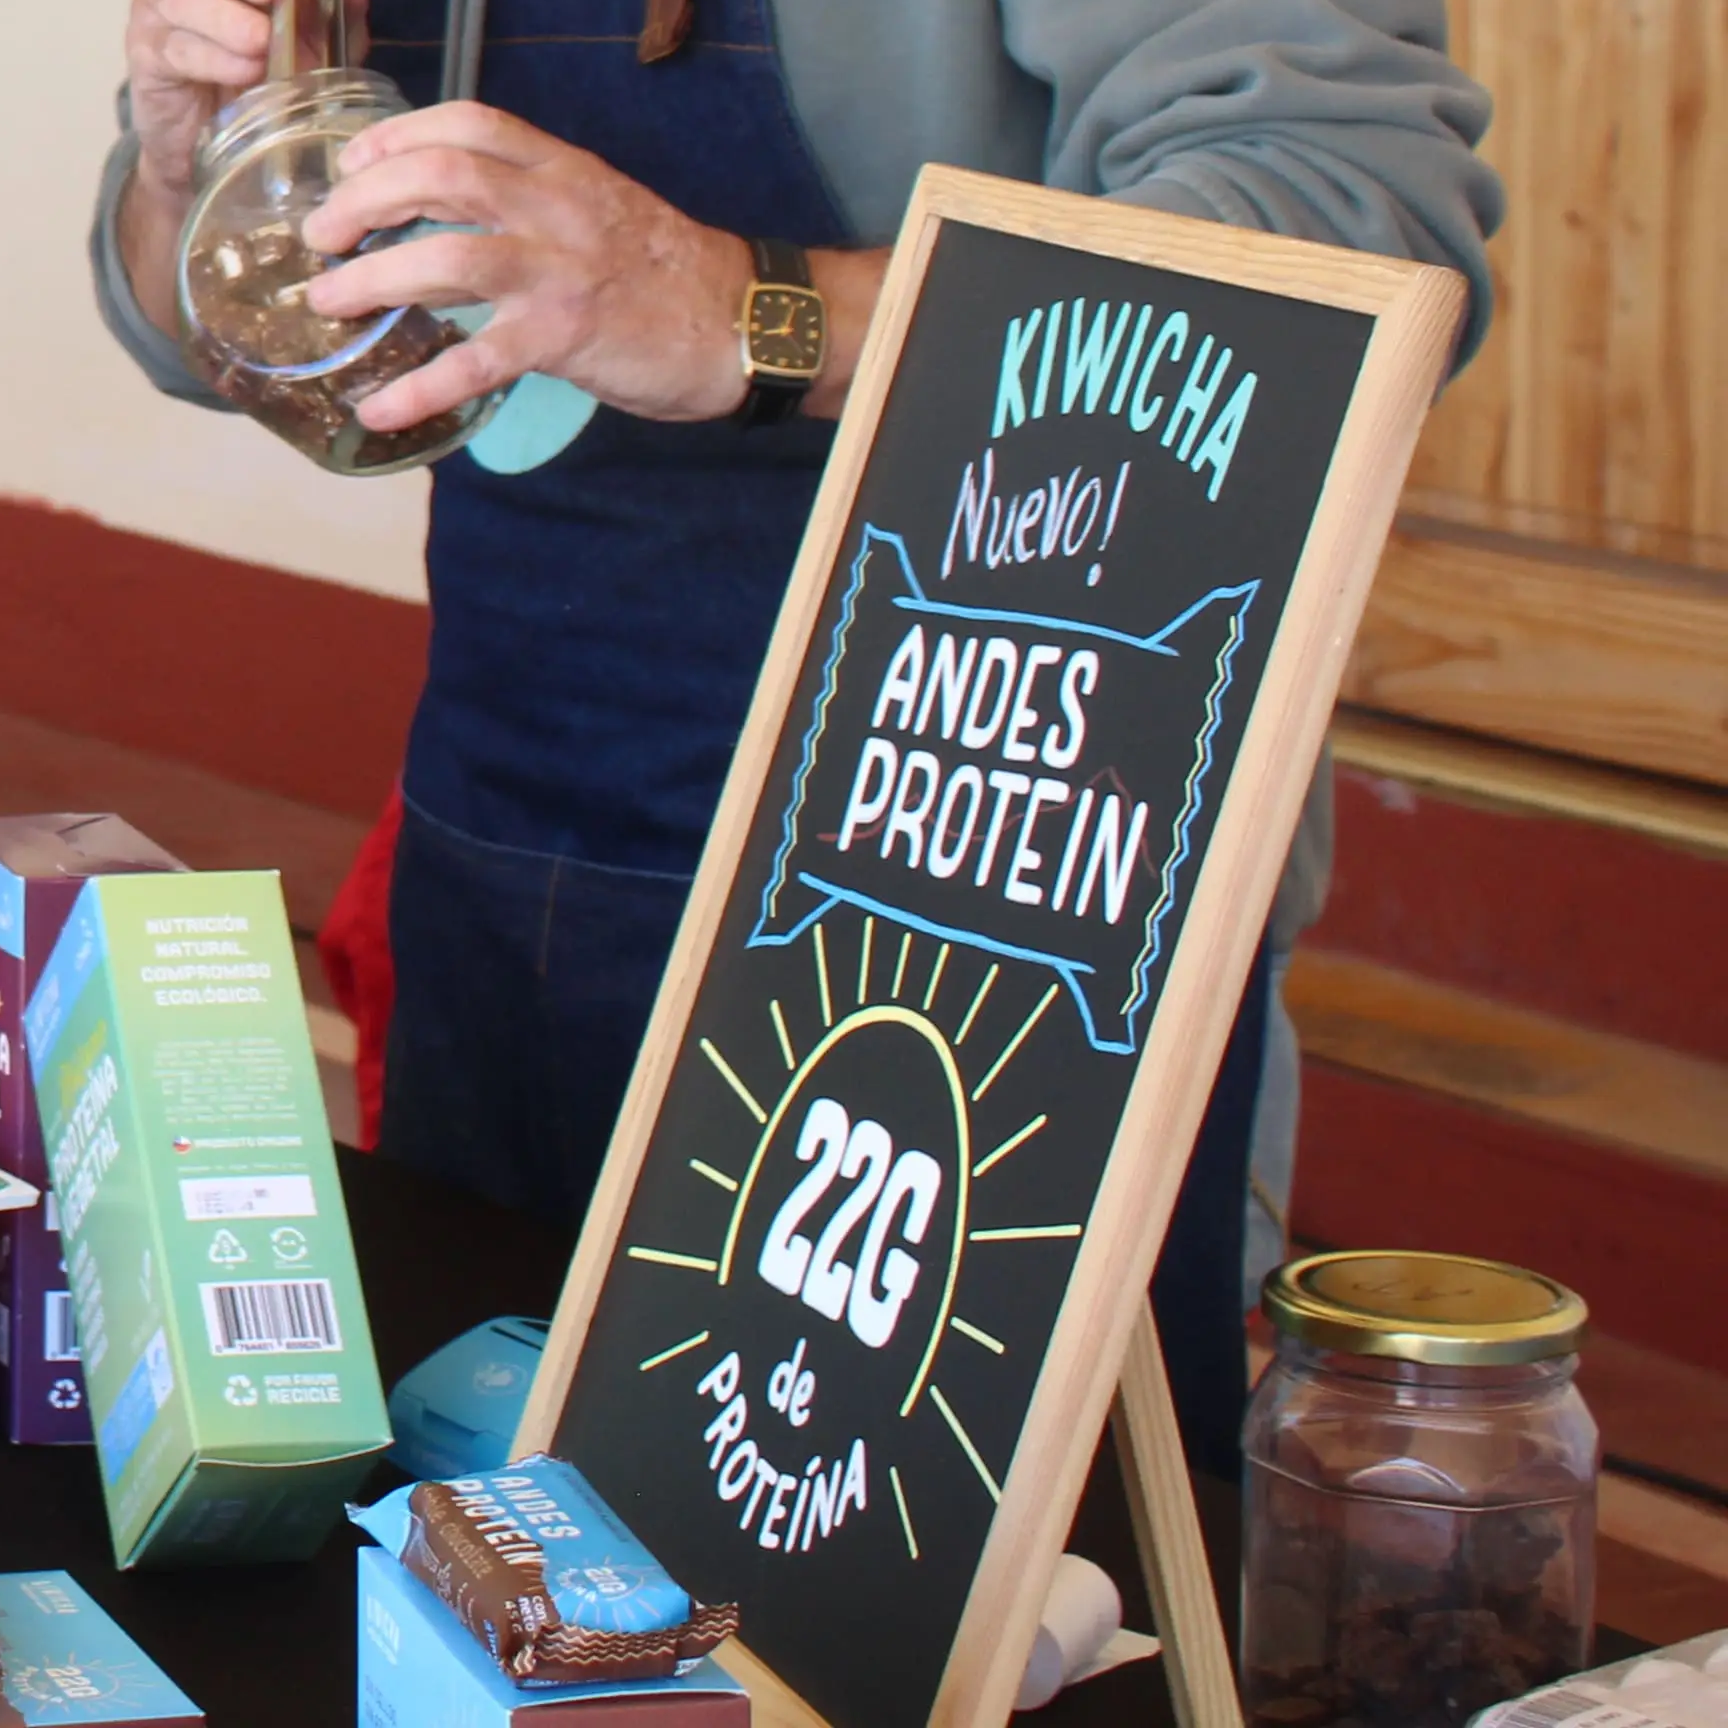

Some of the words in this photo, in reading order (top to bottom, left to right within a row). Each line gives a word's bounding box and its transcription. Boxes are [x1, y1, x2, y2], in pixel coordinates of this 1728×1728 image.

[991, 298, 1258, 502] KIWICHA
[941, 448, 1132, 586] Nuevo!
[872, 624, 1099, 768] ANDES
[838, 737, 1148, 924] PROTEIN
[146, 913, 249, 935] NUTRICIÓN
[141, 963, 272, 983] COMPROMISO
[758, 1097, 941, 1349] 22G
[267, 1387, 342, 1404] RECICLE
[766, 1337, 815, 1427] de
[698, 1351, 867, 1553] PROTEÍNA
[442, 1479, 547, 1565] PROTEIN
[491, 1476, 581, 1540] ANDES
[518, 1596, 534, 1633] neto
